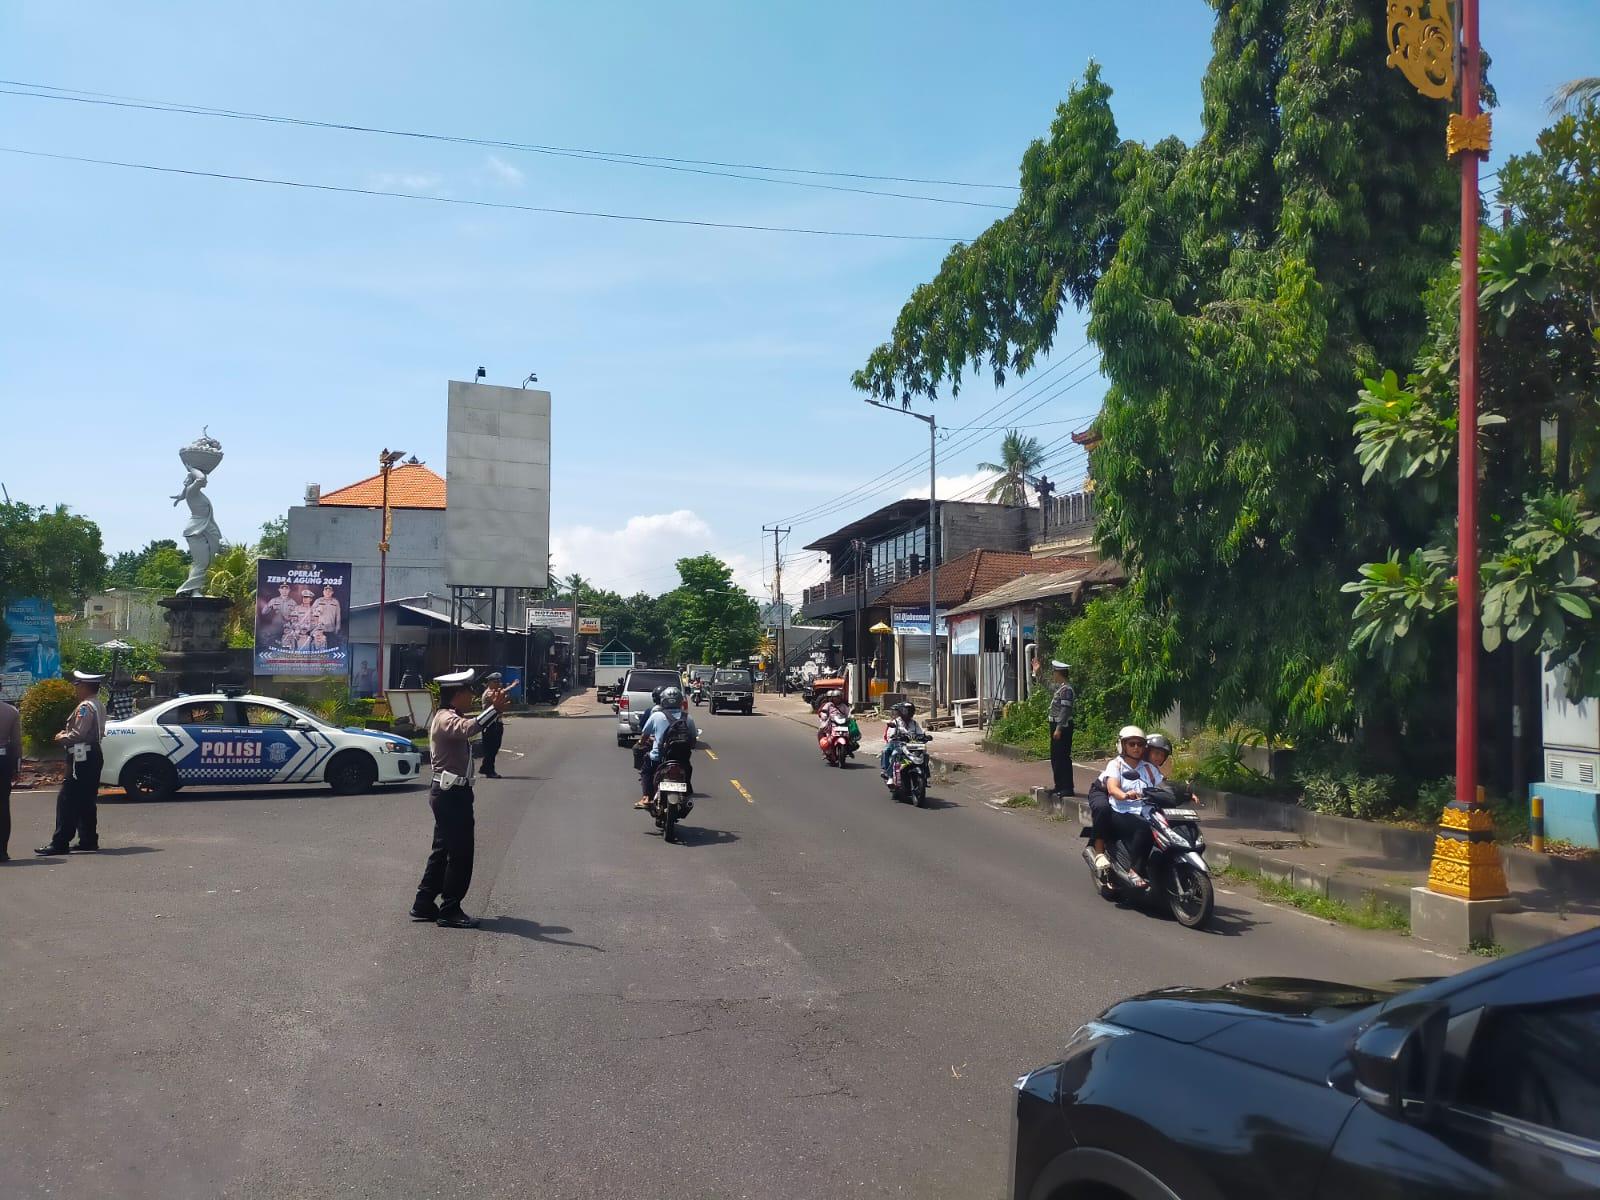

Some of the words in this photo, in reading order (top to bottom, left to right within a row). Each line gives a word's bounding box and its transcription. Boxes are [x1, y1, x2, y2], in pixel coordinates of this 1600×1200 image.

[287, 570, 320, 578] OPERASI
[267, 575, 292, 583] ZEBRA
[293, 577, 322, 585] AGUNG
[322, 578, 343, 586] 2025
[106, 728, 136, 736] PATWAL
[201, 741, 262, 757] POLISI
